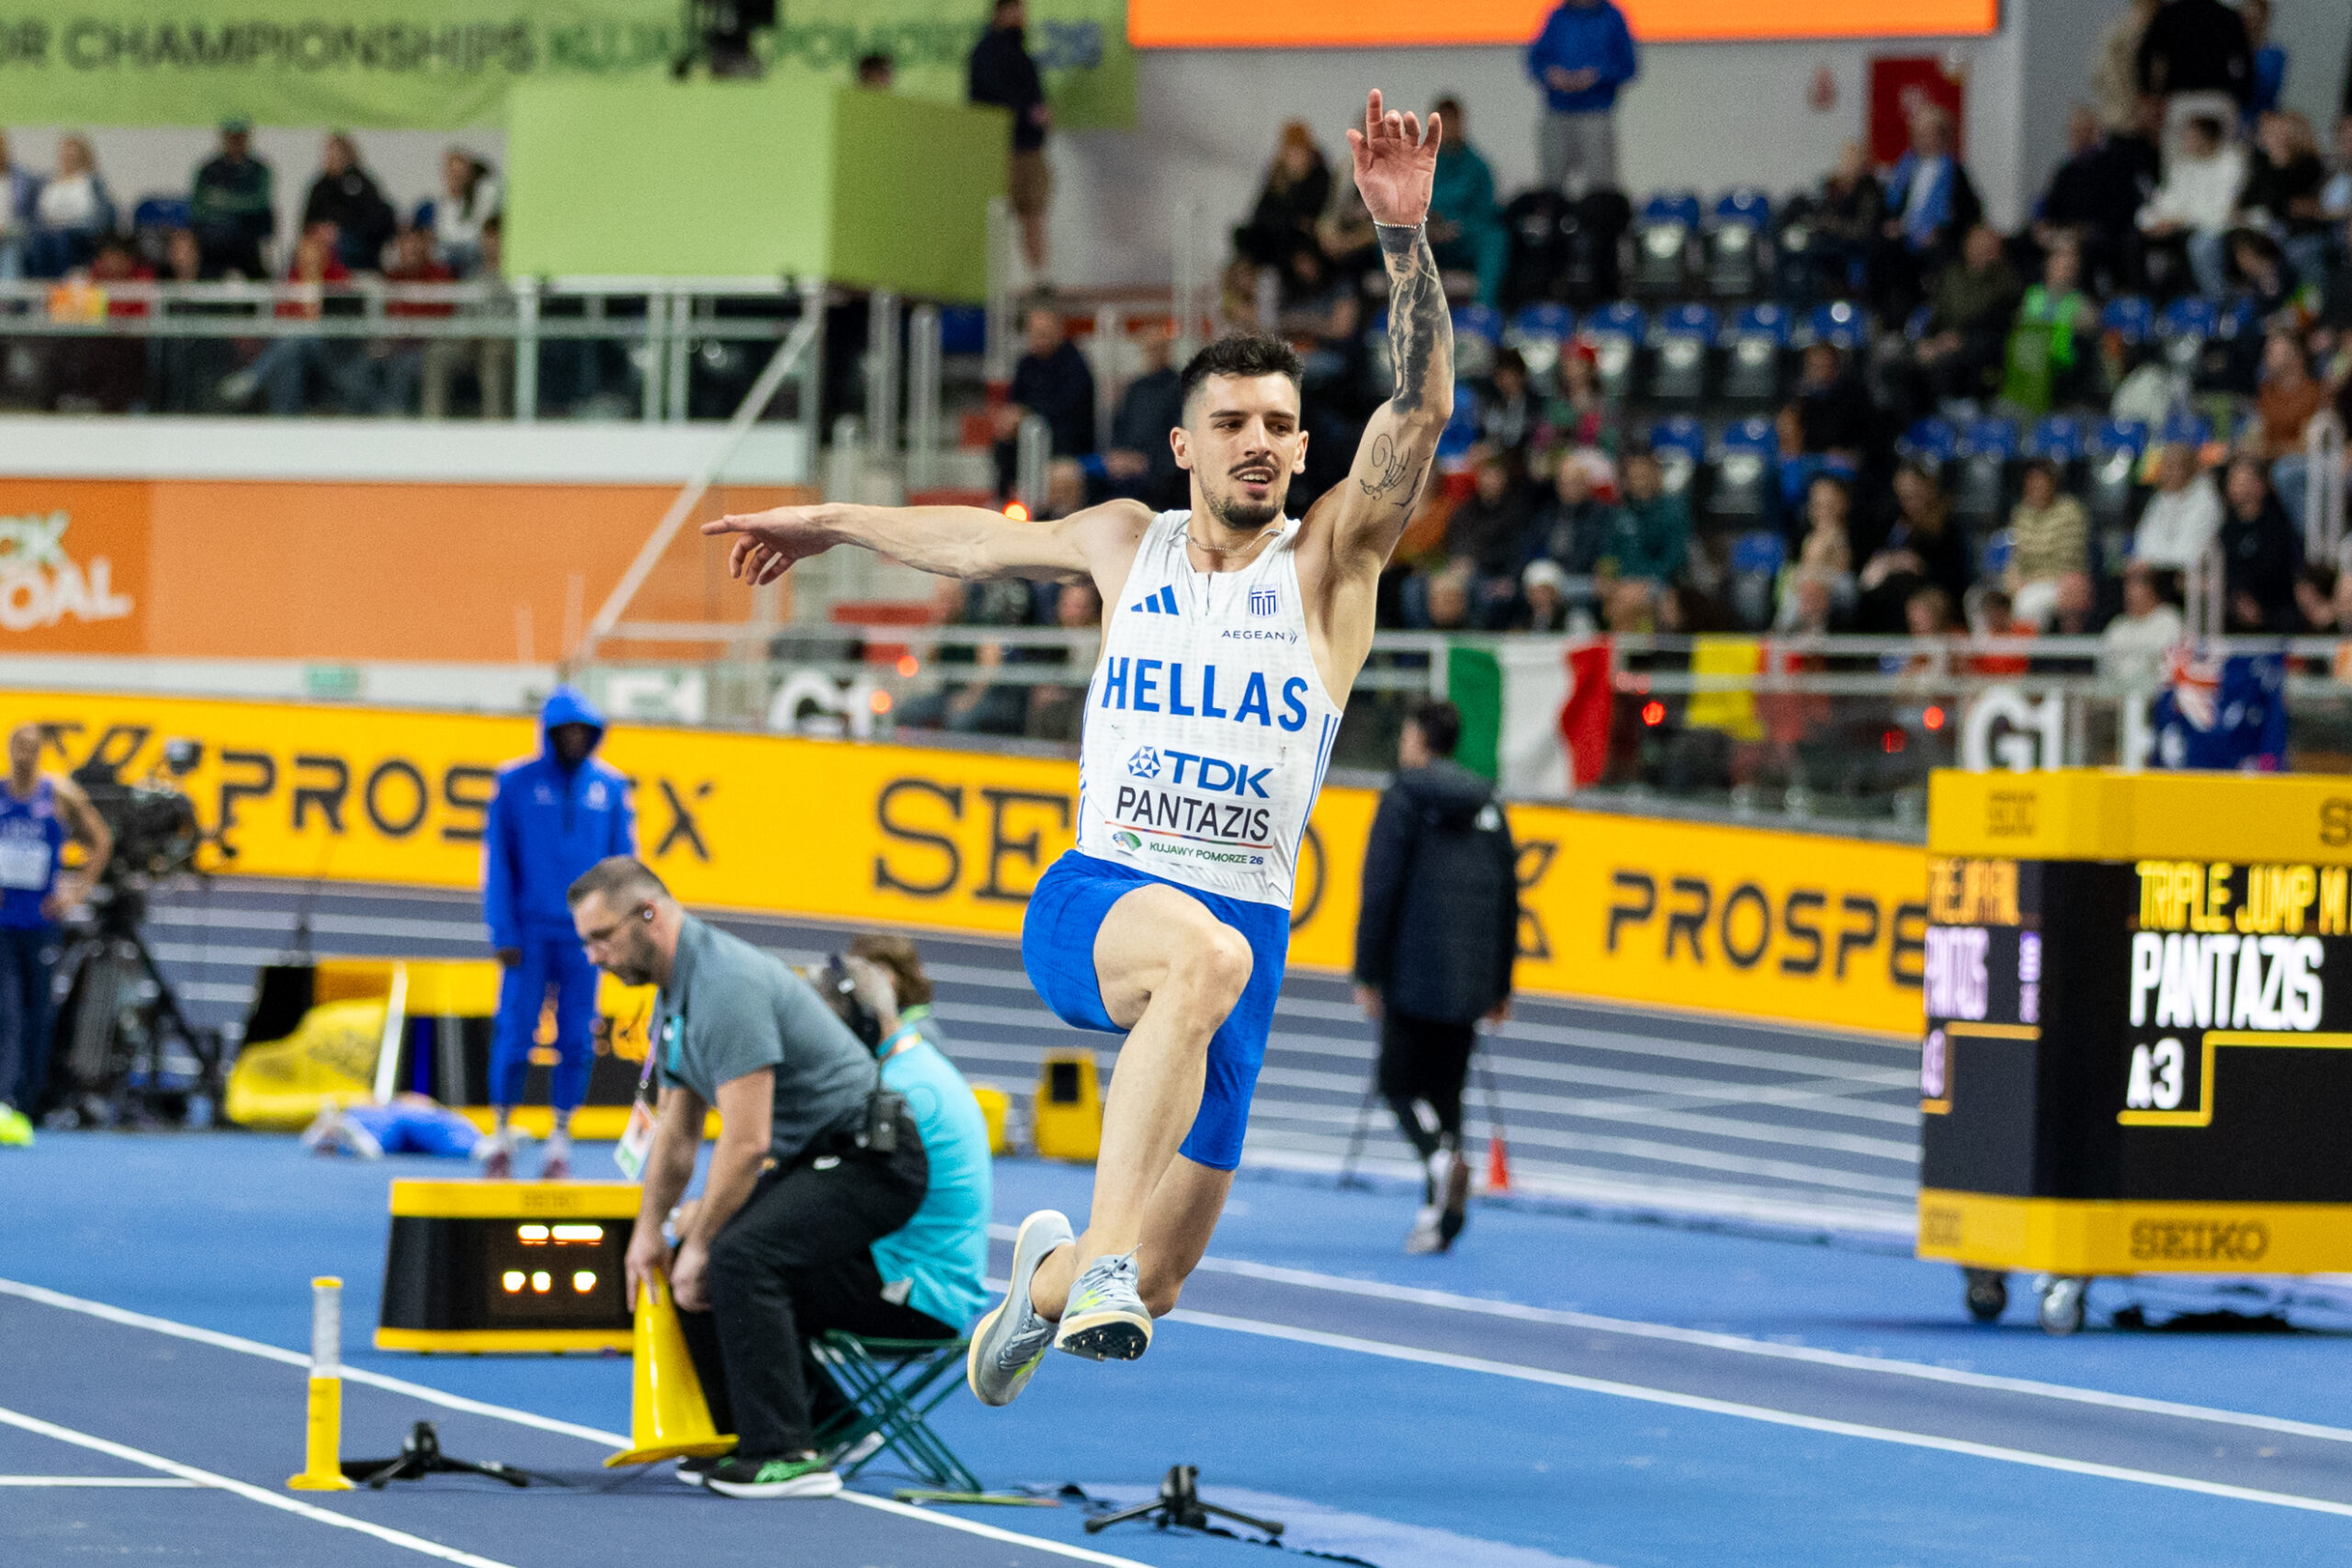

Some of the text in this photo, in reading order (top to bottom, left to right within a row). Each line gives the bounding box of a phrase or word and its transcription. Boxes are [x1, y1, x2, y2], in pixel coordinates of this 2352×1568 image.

[1222, 629, 1285, 640] AEGEAN
[1102, 656, 1309, 732] HELLAS
[1163, 750, 1273, 799] TDK
[221, 749, 715, 862] PROSX
[1116, 786, 1270, 841] PANTAZIS
[1149, 841, 1263, 865] KUJAWY POMORZE 26
[1605, 872, 1928, 987] PROSPE
[2130, 931, 2324, 1032] PANTAZIS
[2130, 1218, 2270, 1261] SEIKO
